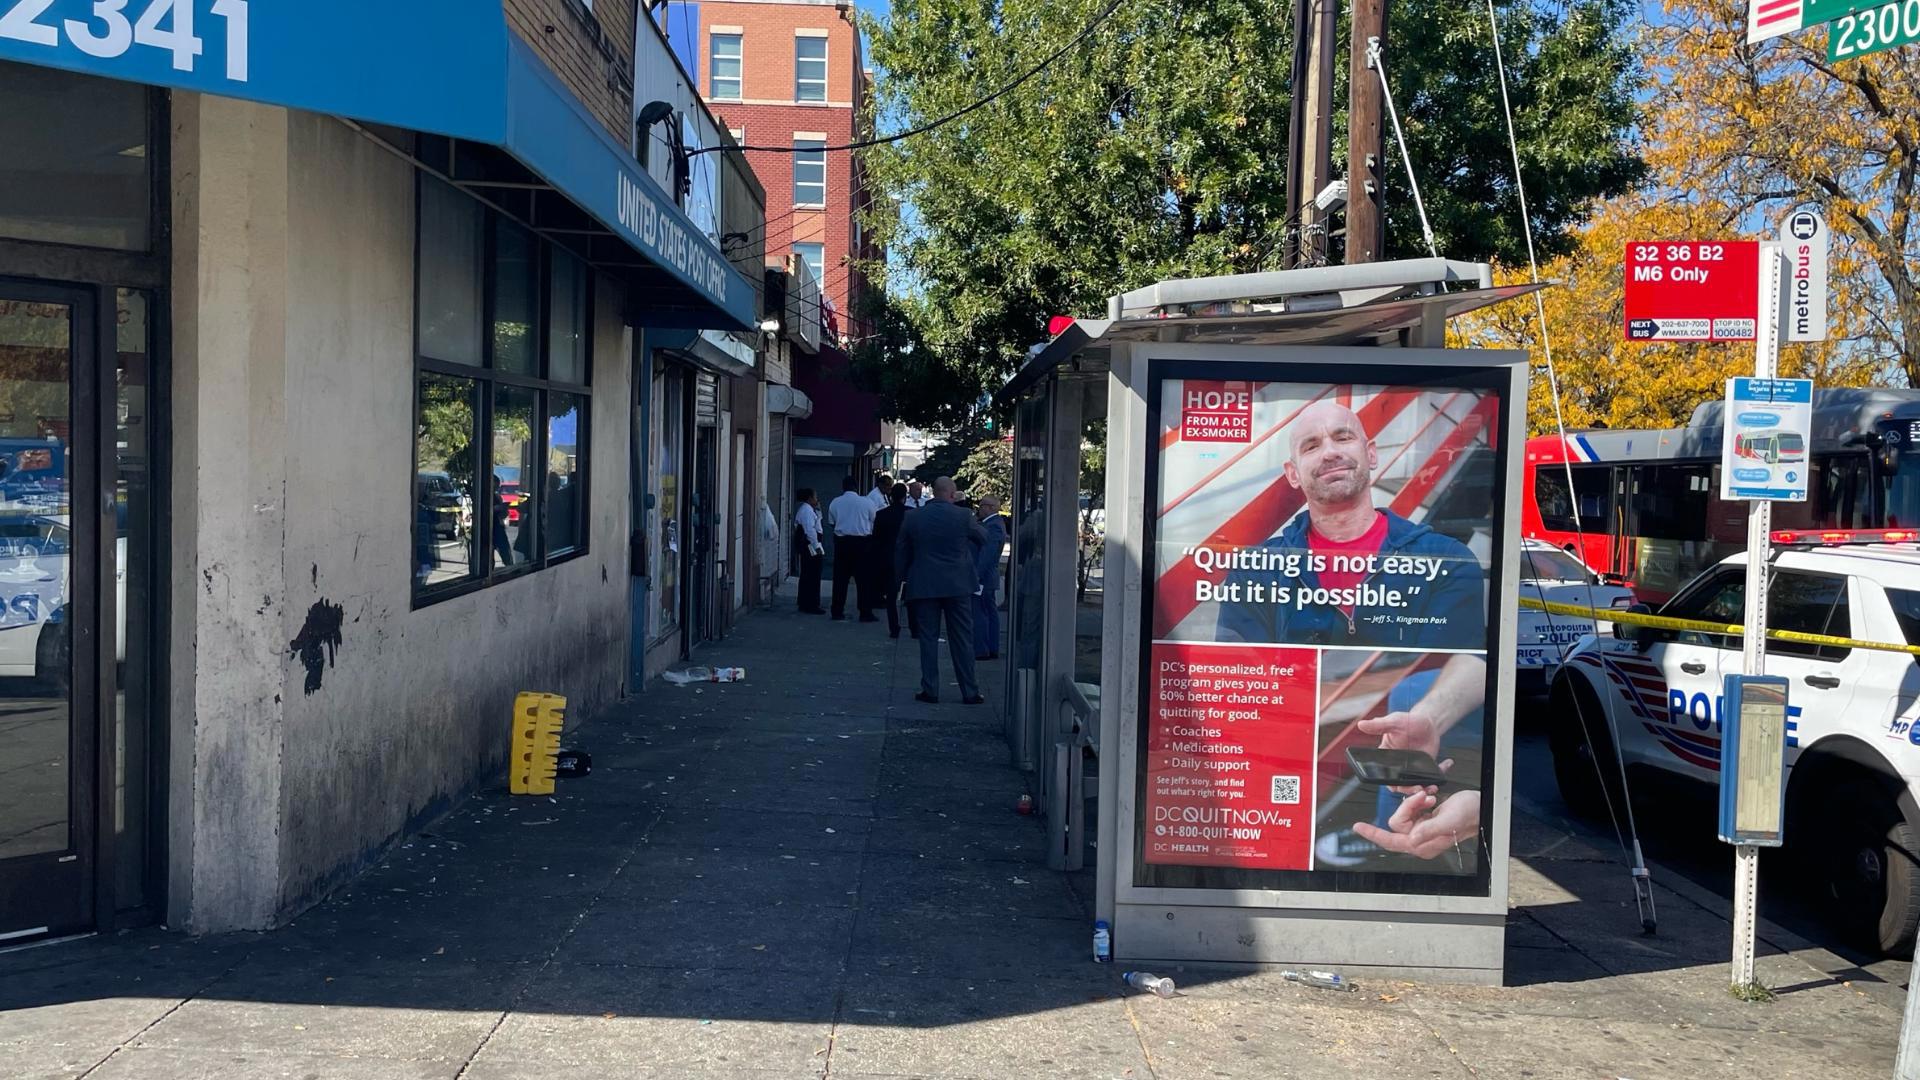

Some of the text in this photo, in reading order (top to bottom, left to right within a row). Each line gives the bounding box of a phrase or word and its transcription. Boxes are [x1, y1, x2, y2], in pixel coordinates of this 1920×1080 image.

[1836, 0, 1920, 57] 2300
[618, 170, 726, 303] UNITED STATES POST OFFICE
[1635, 246, 1724, 261] 32 36 B2
[1634, 266, 1709, 284] M6 Only
[1795, 245, 1810, 335] metrobus
[1662, 320, 1708, 328] 202-637-7000
[1662, 329, 1708, 337] WMATA.COM
[1714, 329, 1752, 337] 1000482
[1188, 390, 1249, 410] HOPE
[1186, 416, 1248, 427] FROM A DC
[1186, 428, 1247, 438] EX-SMOKER
[1182, 546, 1448, 581] “Quitting is not easy.
[1196, 580, 1421, 610] But it is possible.”
[1371, 615, 1386, 624] Jeff
[1396, 616, 1428, 625] Kingman
[1430, 616, 1448, 624] Park
[1535, 624, 1593, 632] METROPOLITAN
[1160, 661, 1294, 677] DC's personalized, free
[1160, 677, 1279, 692] program gives you a
[1160, 690, 1284, 705] 60% better chance at
[1160, 706, 1261, 722] quitting for good.
[1669, 689, 1803, 748] POE
[1172, 725, 1222, 738] Coaches
[1172, 742, 1244, 754] Medications
[1171, 757, 1251, 772] Daily support
[1157, 776, 1244, 787] See Jeff's story, and find
[1157, 787, 1246, 799] out what's right for you.
[1155, 806, 1292, 828] DCQUITNOW.org
[1168, 826, 1261, 840] 1-800-QUIT-NOW
[1155, 843, 1168, 851] DC
[1171, 844, 1209, 853] HEALTH
